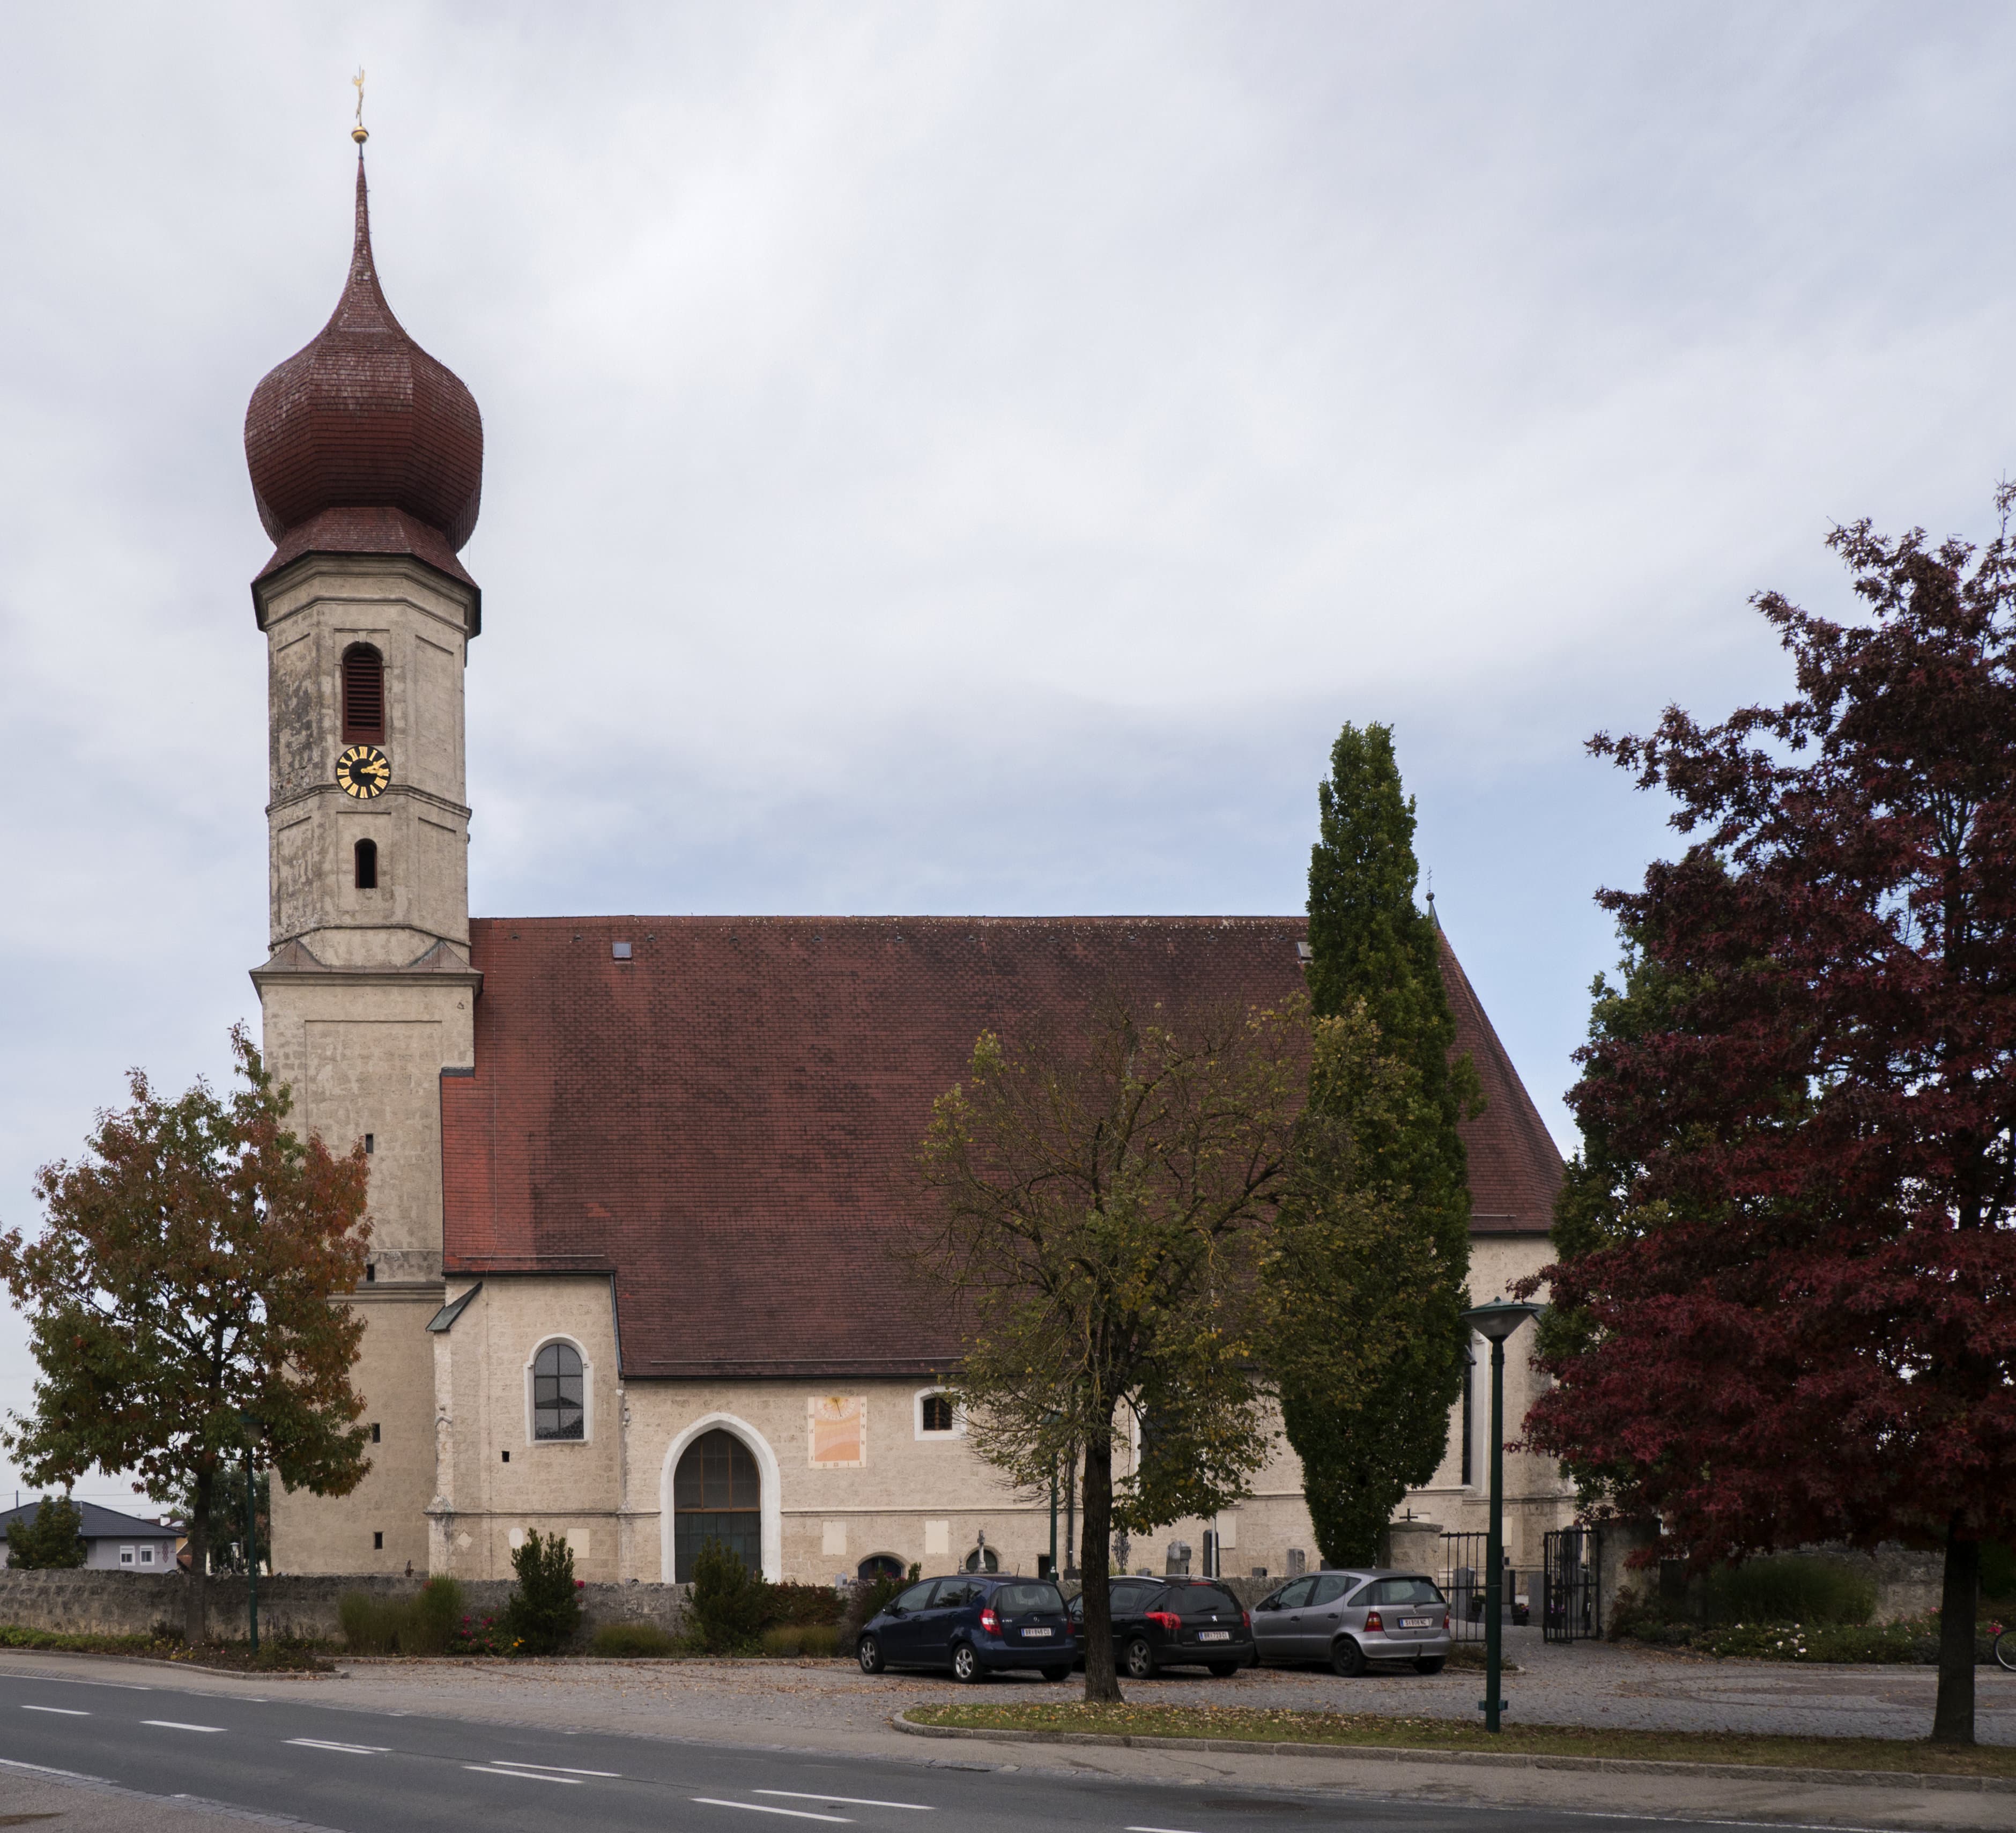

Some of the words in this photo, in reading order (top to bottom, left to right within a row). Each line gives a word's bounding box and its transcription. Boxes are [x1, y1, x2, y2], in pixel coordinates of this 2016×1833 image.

[347, 748, 359, 762] XI
[359, 746, 368, 759] XII
[368, 749, 377, 761] I
[339, 756, 352, 767] X
[337, 767, 350, 776] IX
[347, 783, 359, 796] VII
[359, 786, 368, 798] VI
[369, 784, 380, 796] V
